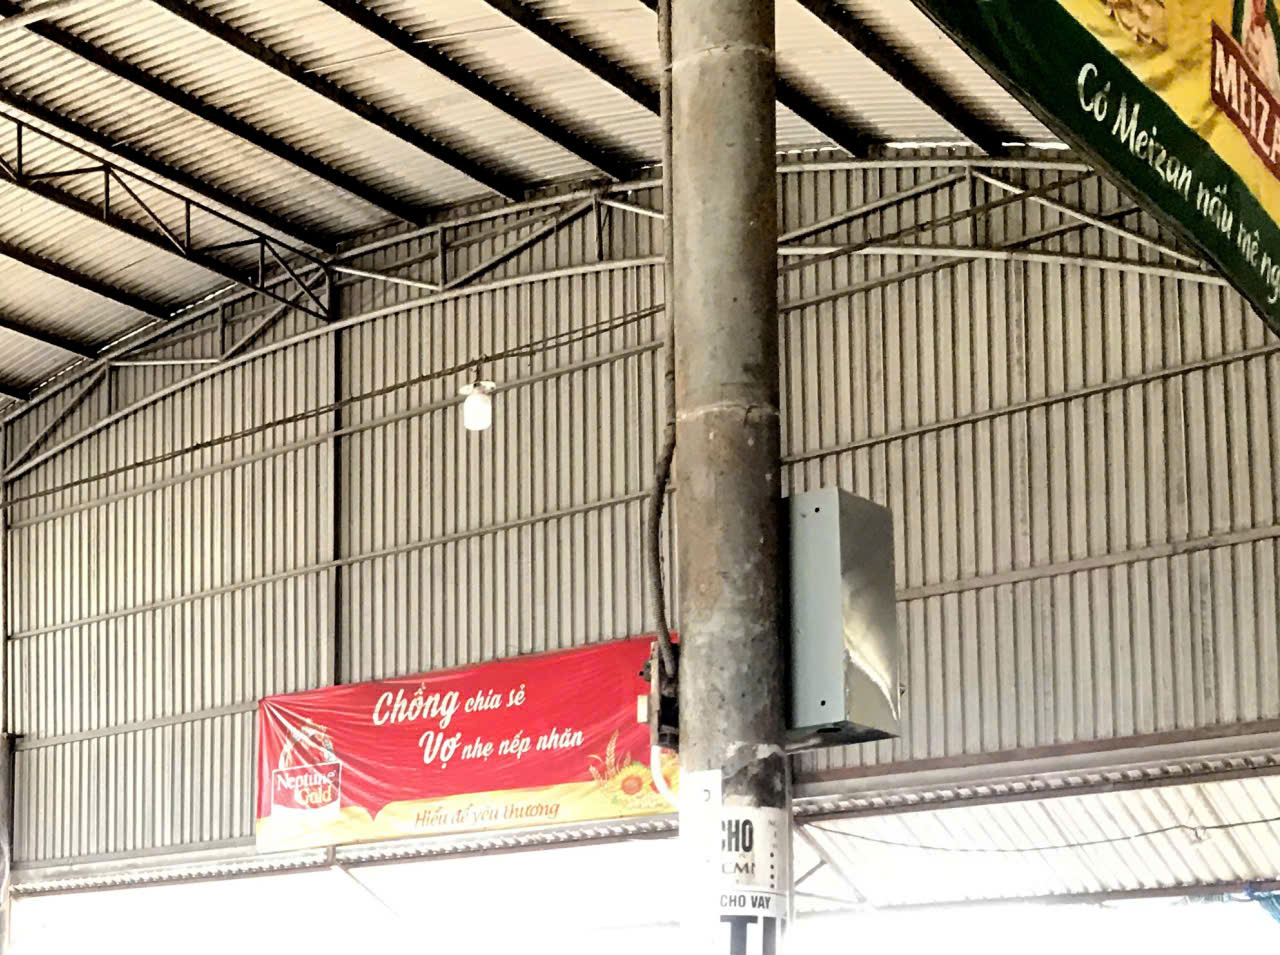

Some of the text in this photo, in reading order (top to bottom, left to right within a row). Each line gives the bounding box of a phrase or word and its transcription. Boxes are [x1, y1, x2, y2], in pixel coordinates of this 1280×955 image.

[1111, 94, 1193, 200] Meizan
[372, 681, 526, 729] Chồng chia sẻ
[418, 727, 585, 769] Vợ nhẹ nếp nhăn
[276, 771, 335, 792] Neptune
[295, 783, 333, 806] Gold
[720, 894, 772, 910] CHO VAY
